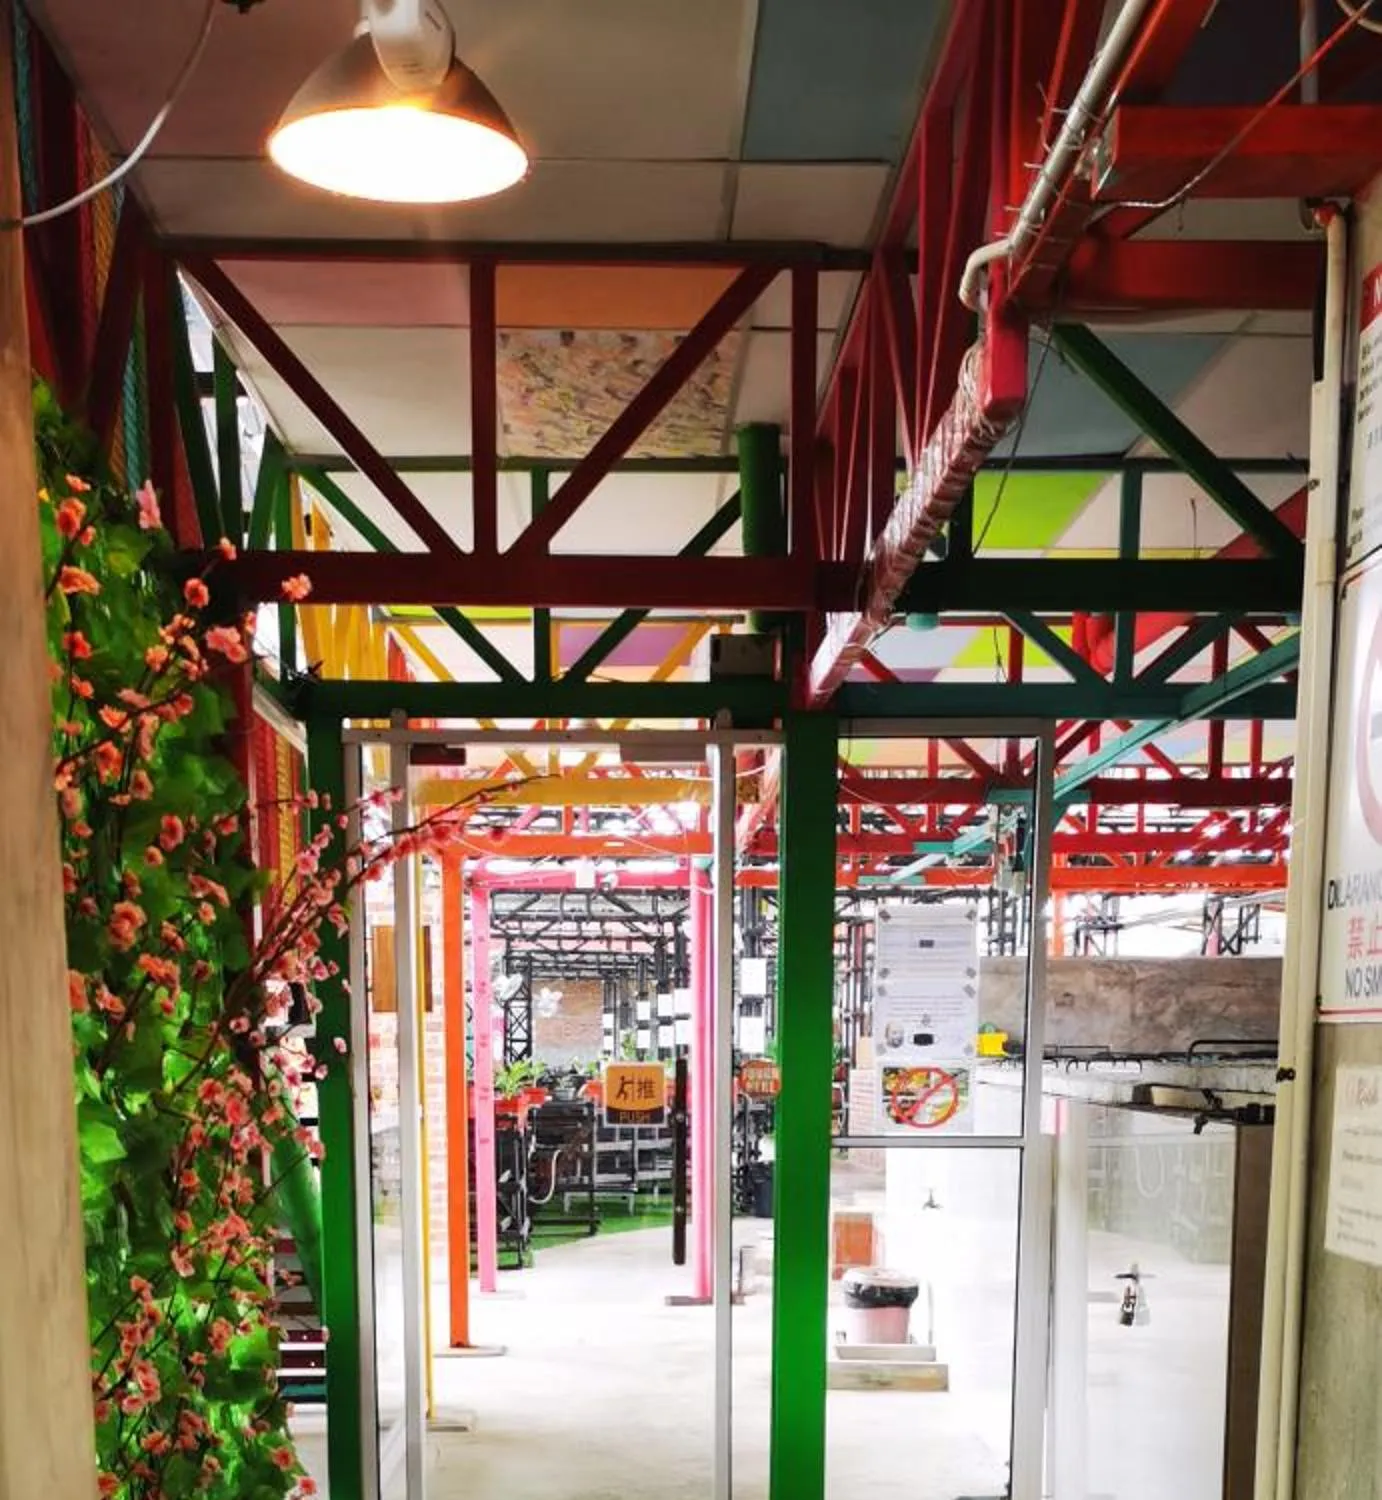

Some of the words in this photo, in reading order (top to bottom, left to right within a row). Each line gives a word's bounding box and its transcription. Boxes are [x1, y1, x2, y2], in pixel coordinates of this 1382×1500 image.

[1345, 968, 1363, 998] NO
[637, 1076, 656, 1100] 推
[619, 1111, 650, 1124] PUSH
